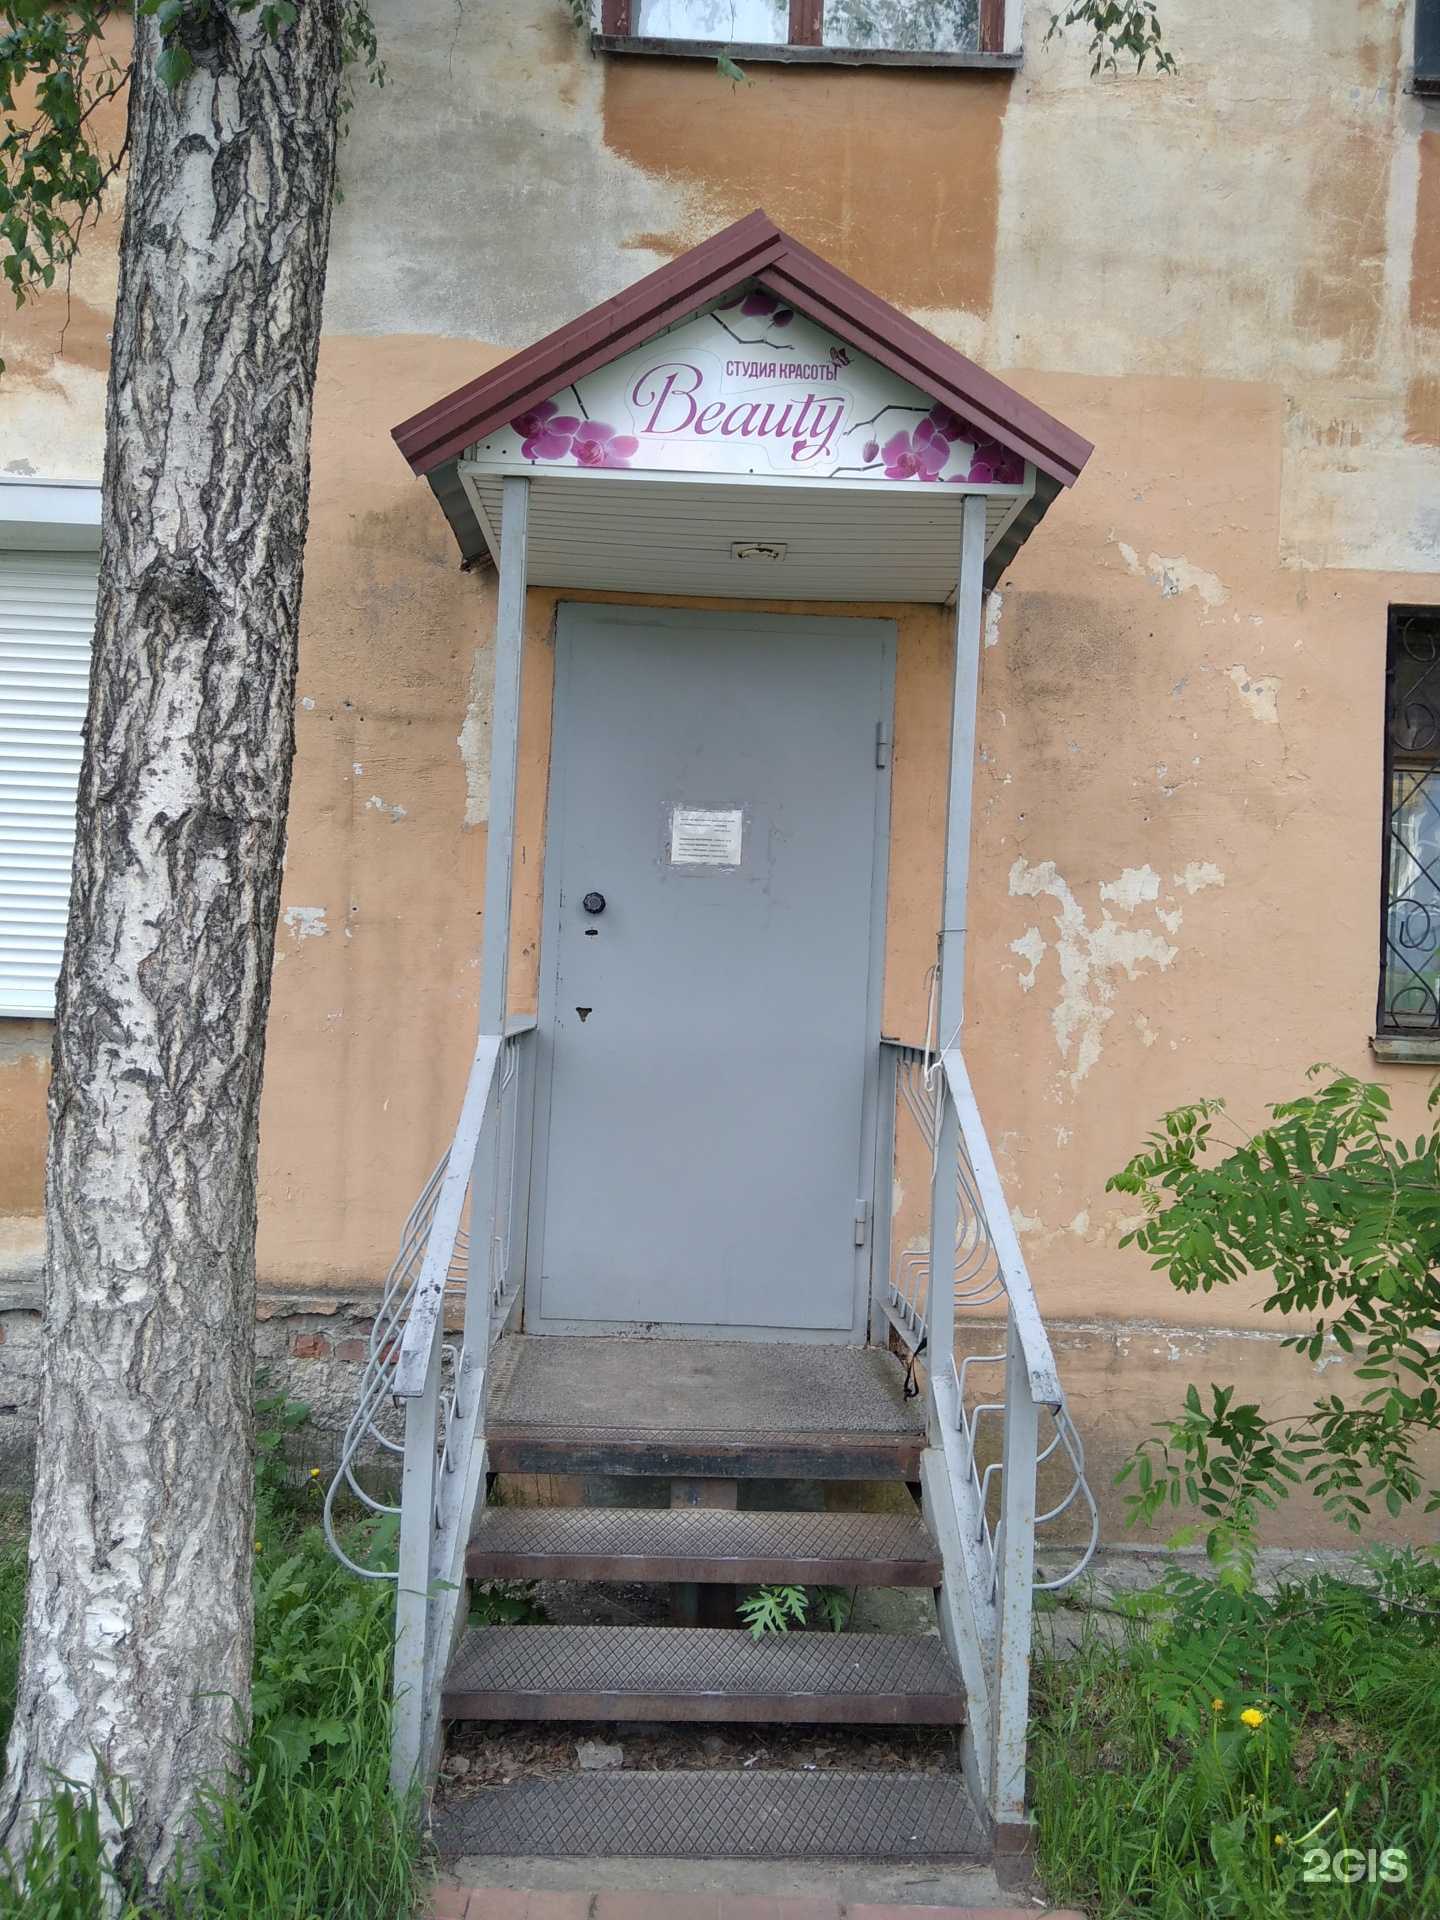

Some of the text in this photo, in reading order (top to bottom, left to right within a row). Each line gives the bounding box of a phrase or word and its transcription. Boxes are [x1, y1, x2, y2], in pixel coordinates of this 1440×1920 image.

[726, 360, 838, 381] СТУДИЯ КРАСОТЫ
[632, 362, 845, 461] Beauty
